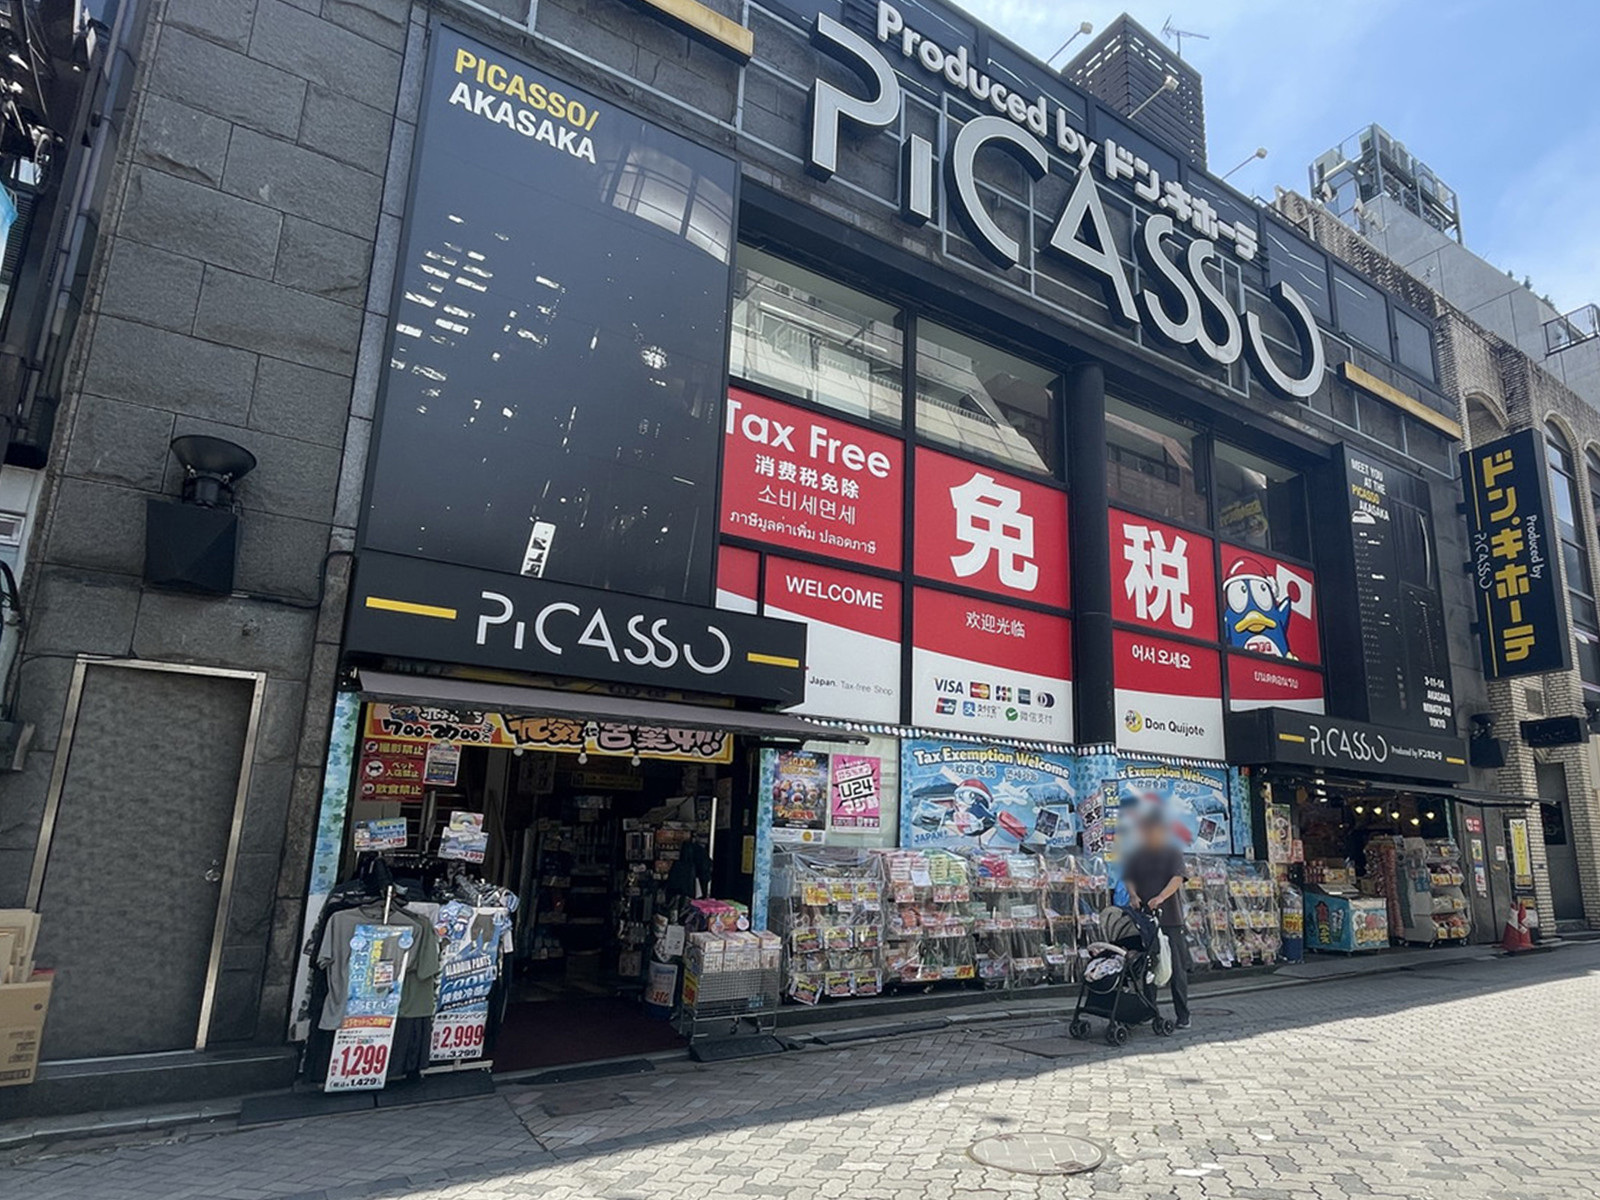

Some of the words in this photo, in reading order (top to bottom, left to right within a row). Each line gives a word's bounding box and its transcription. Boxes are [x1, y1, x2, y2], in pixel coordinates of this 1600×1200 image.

[877, 2, 1047, 138] Produced
[1056, 107, 1097, 171] by
[449, 82, 597, 164] AKASAKA
[809, 424, 892, 478] Free
[1350, 458, 1369, 476] MEET
[1369, 464, 1384, 482] YOU
[1363, 475, 1375, 490] AT
[1359, 500, 1390, 523] AKASAKA
[949, 472, 1039, 592] 免
[1526, 514, 1541, 563] Produced
[1122, 523, 1193, 629] 税
[1529, 563, 1545, 580] by
[785, 575, 883, 610] WELCOME
[966, 611, 1026, 639] 欢迎光临
[1131, 644, 1156, 662] 어서
[1158, 647, 1191, 669] 오세요
[934, 677, 964, 695] VISA
[1145, 717, 1166, 732] Don
[1168, 718, 1205, 737] Quijote
[914, 749, 942, 766] Tax
[941, 746, 1014, 764] Exemption
[1014, 751, 1071, 780] Welcome
[841, 779, 873, 798] U24
[1126, 766, 1181, 779] Exemption
[1182, 768, 1224, 791] Welcome
[440, 1024, 485, 1049] 2,999
[340, 1043, 389, 1079] 1,299
